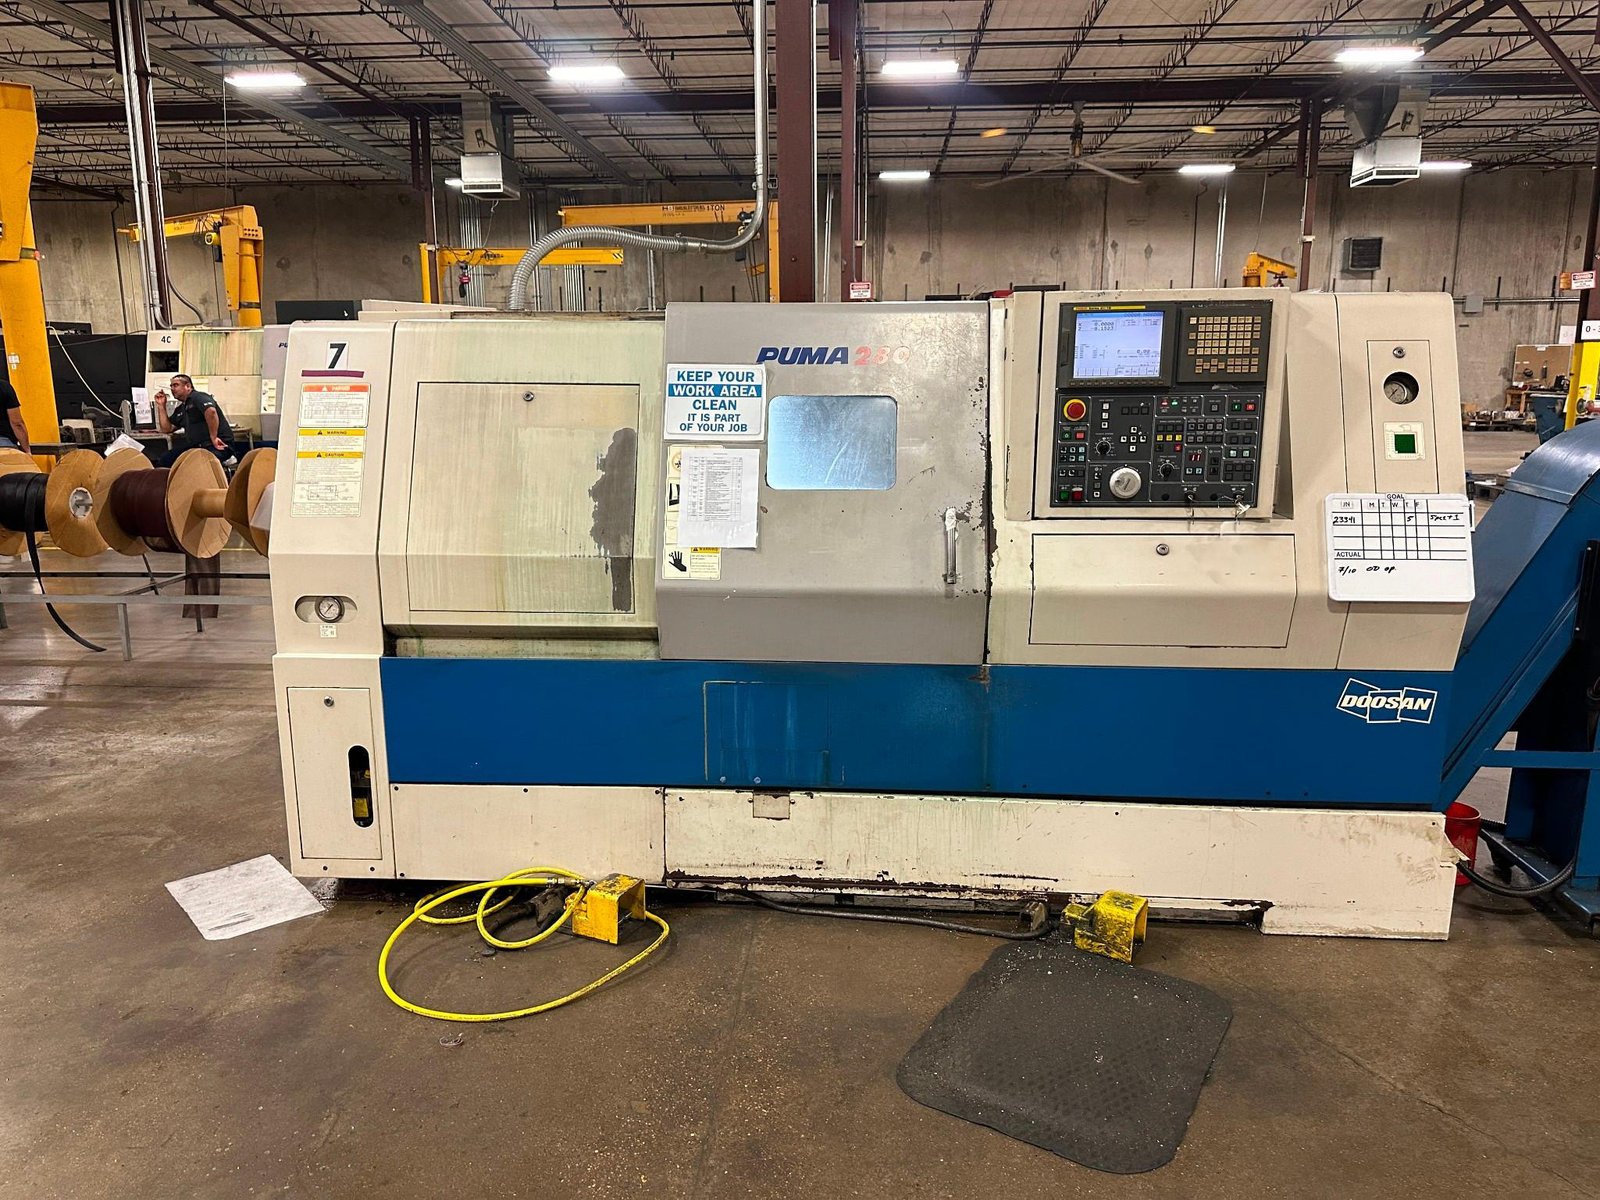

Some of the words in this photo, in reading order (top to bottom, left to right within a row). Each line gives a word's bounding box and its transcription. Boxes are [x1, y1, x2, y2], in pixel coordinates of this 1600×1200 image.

[161, 335, 171, 343] 4C
[328, 343, 346, 369] 7
[756, 347, 849, 365] PUMA
[854, 346, 911, 366] 280
[677, 371, 713, 383] KEEP
[717, 371, 755, 382] YOUR
[672, 385, 715, 396] WORK
[720, 385, 757, 397] AREA
[692, 399, 737, 411] CLEAN
[687, 414, 697, 422] IT
[700, 414, 710, 422] IS
[714, 414, 741, 422] PART
[679, 423, 694, 432] OF
[697, 423, 725, 432] YOUR
[728, 424, 748, 432] JOB
[1340, 695, 1432, 710] DOOSAN
